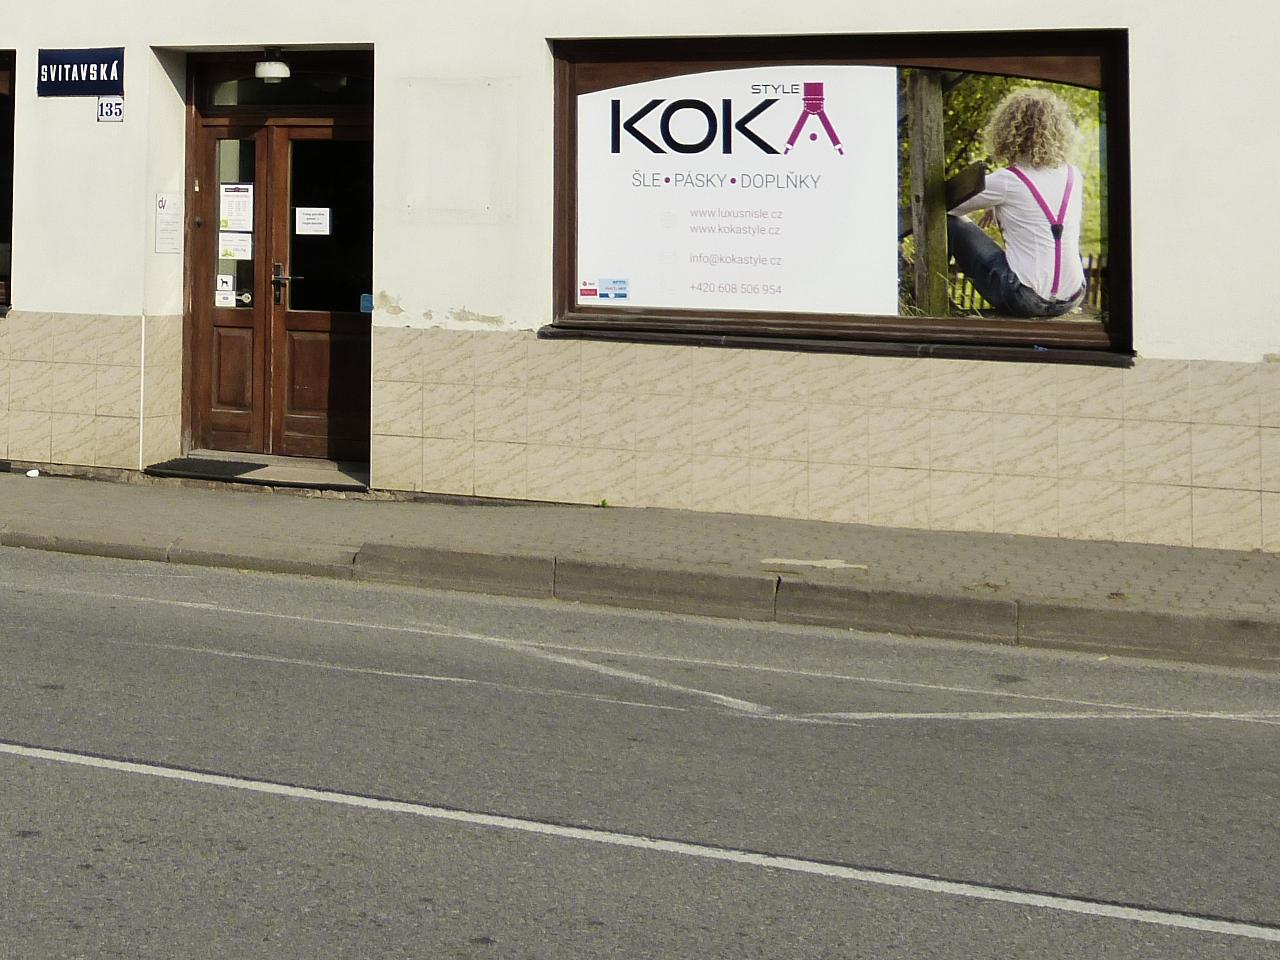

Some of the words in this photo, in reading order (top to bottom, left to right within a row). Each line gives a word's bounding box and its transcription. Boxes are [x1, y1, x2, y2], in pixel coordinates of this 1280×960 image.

[40, 60, 119, 82] SVITAVSKÁ
[751, 84, 800, 94] STYLE
[99, 102, 122, 117] 135
[631, 169, 661, 188] ŠLE
[674, 170, 728, 188] PÁSKY
[741, 171, 822, 189] DOPLŇKY
[690, 224, 781, 236] www.kokastyle.cz
[690, 253, 783, 266] info@kokastyle.cz
[690, 282, 716, 293] +420
